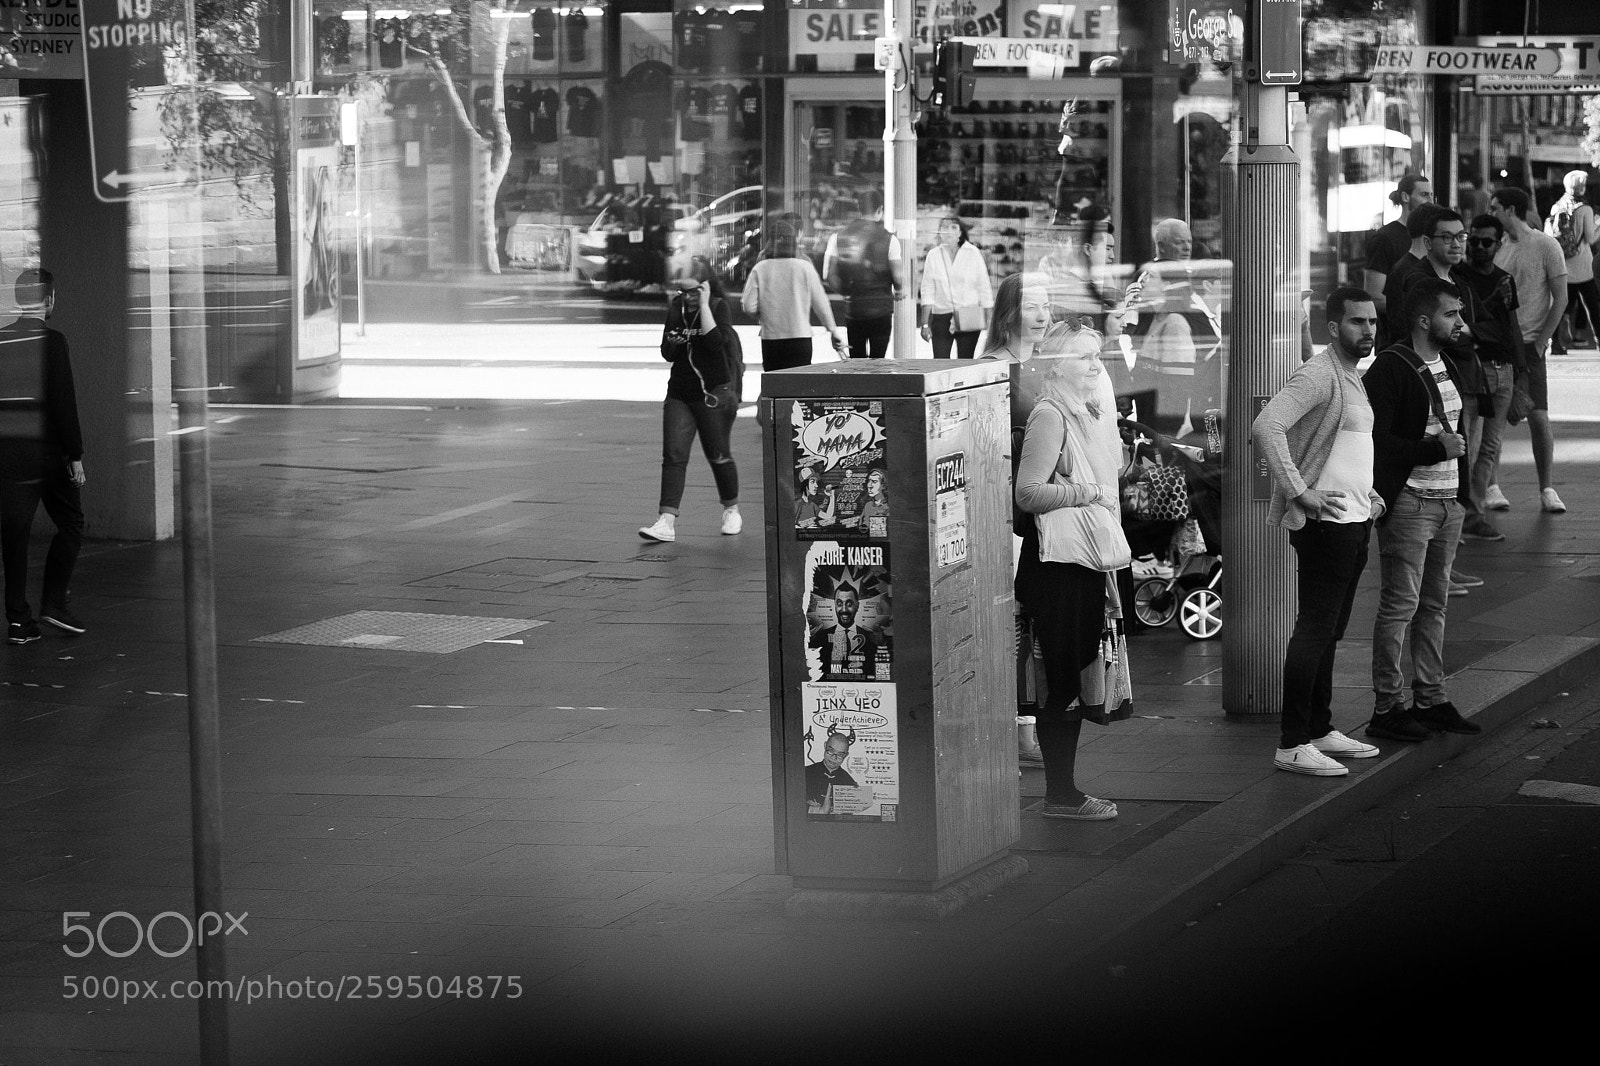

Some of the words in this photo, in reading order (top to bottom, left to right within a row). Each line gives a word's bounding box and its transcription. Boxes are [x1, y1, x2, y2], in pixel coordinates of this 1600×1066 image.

[118, 0, 150, 19] NO
[25, 13, 80, 27] STUDIO
[806, 13, 880, 41] SALE
[1023, 9, 1100, 39] SALE
[1188, 8, 1226, 48] George
[88, 20, 186, 48] STOPPING
[11, 39, 73, 53] SYDNEY
[975, 43, 996, 60] BEN
[1377, 50, 1413, 67] BEN
[1426, 51, 1538, 70] FOOTWEAR
[817, 431, 866, 457] MAMA
[936, 458, 965, 491] EC7244
[847, 546, 883, 565] KAISER
[950, 537, 965, 559] 700
[830, 664, 843, 674] MAY
[812, 697, 847, 713] JINX
[854, 697, 881, 711] YEO
[829, 714, 884, 725] UnderAchiever
